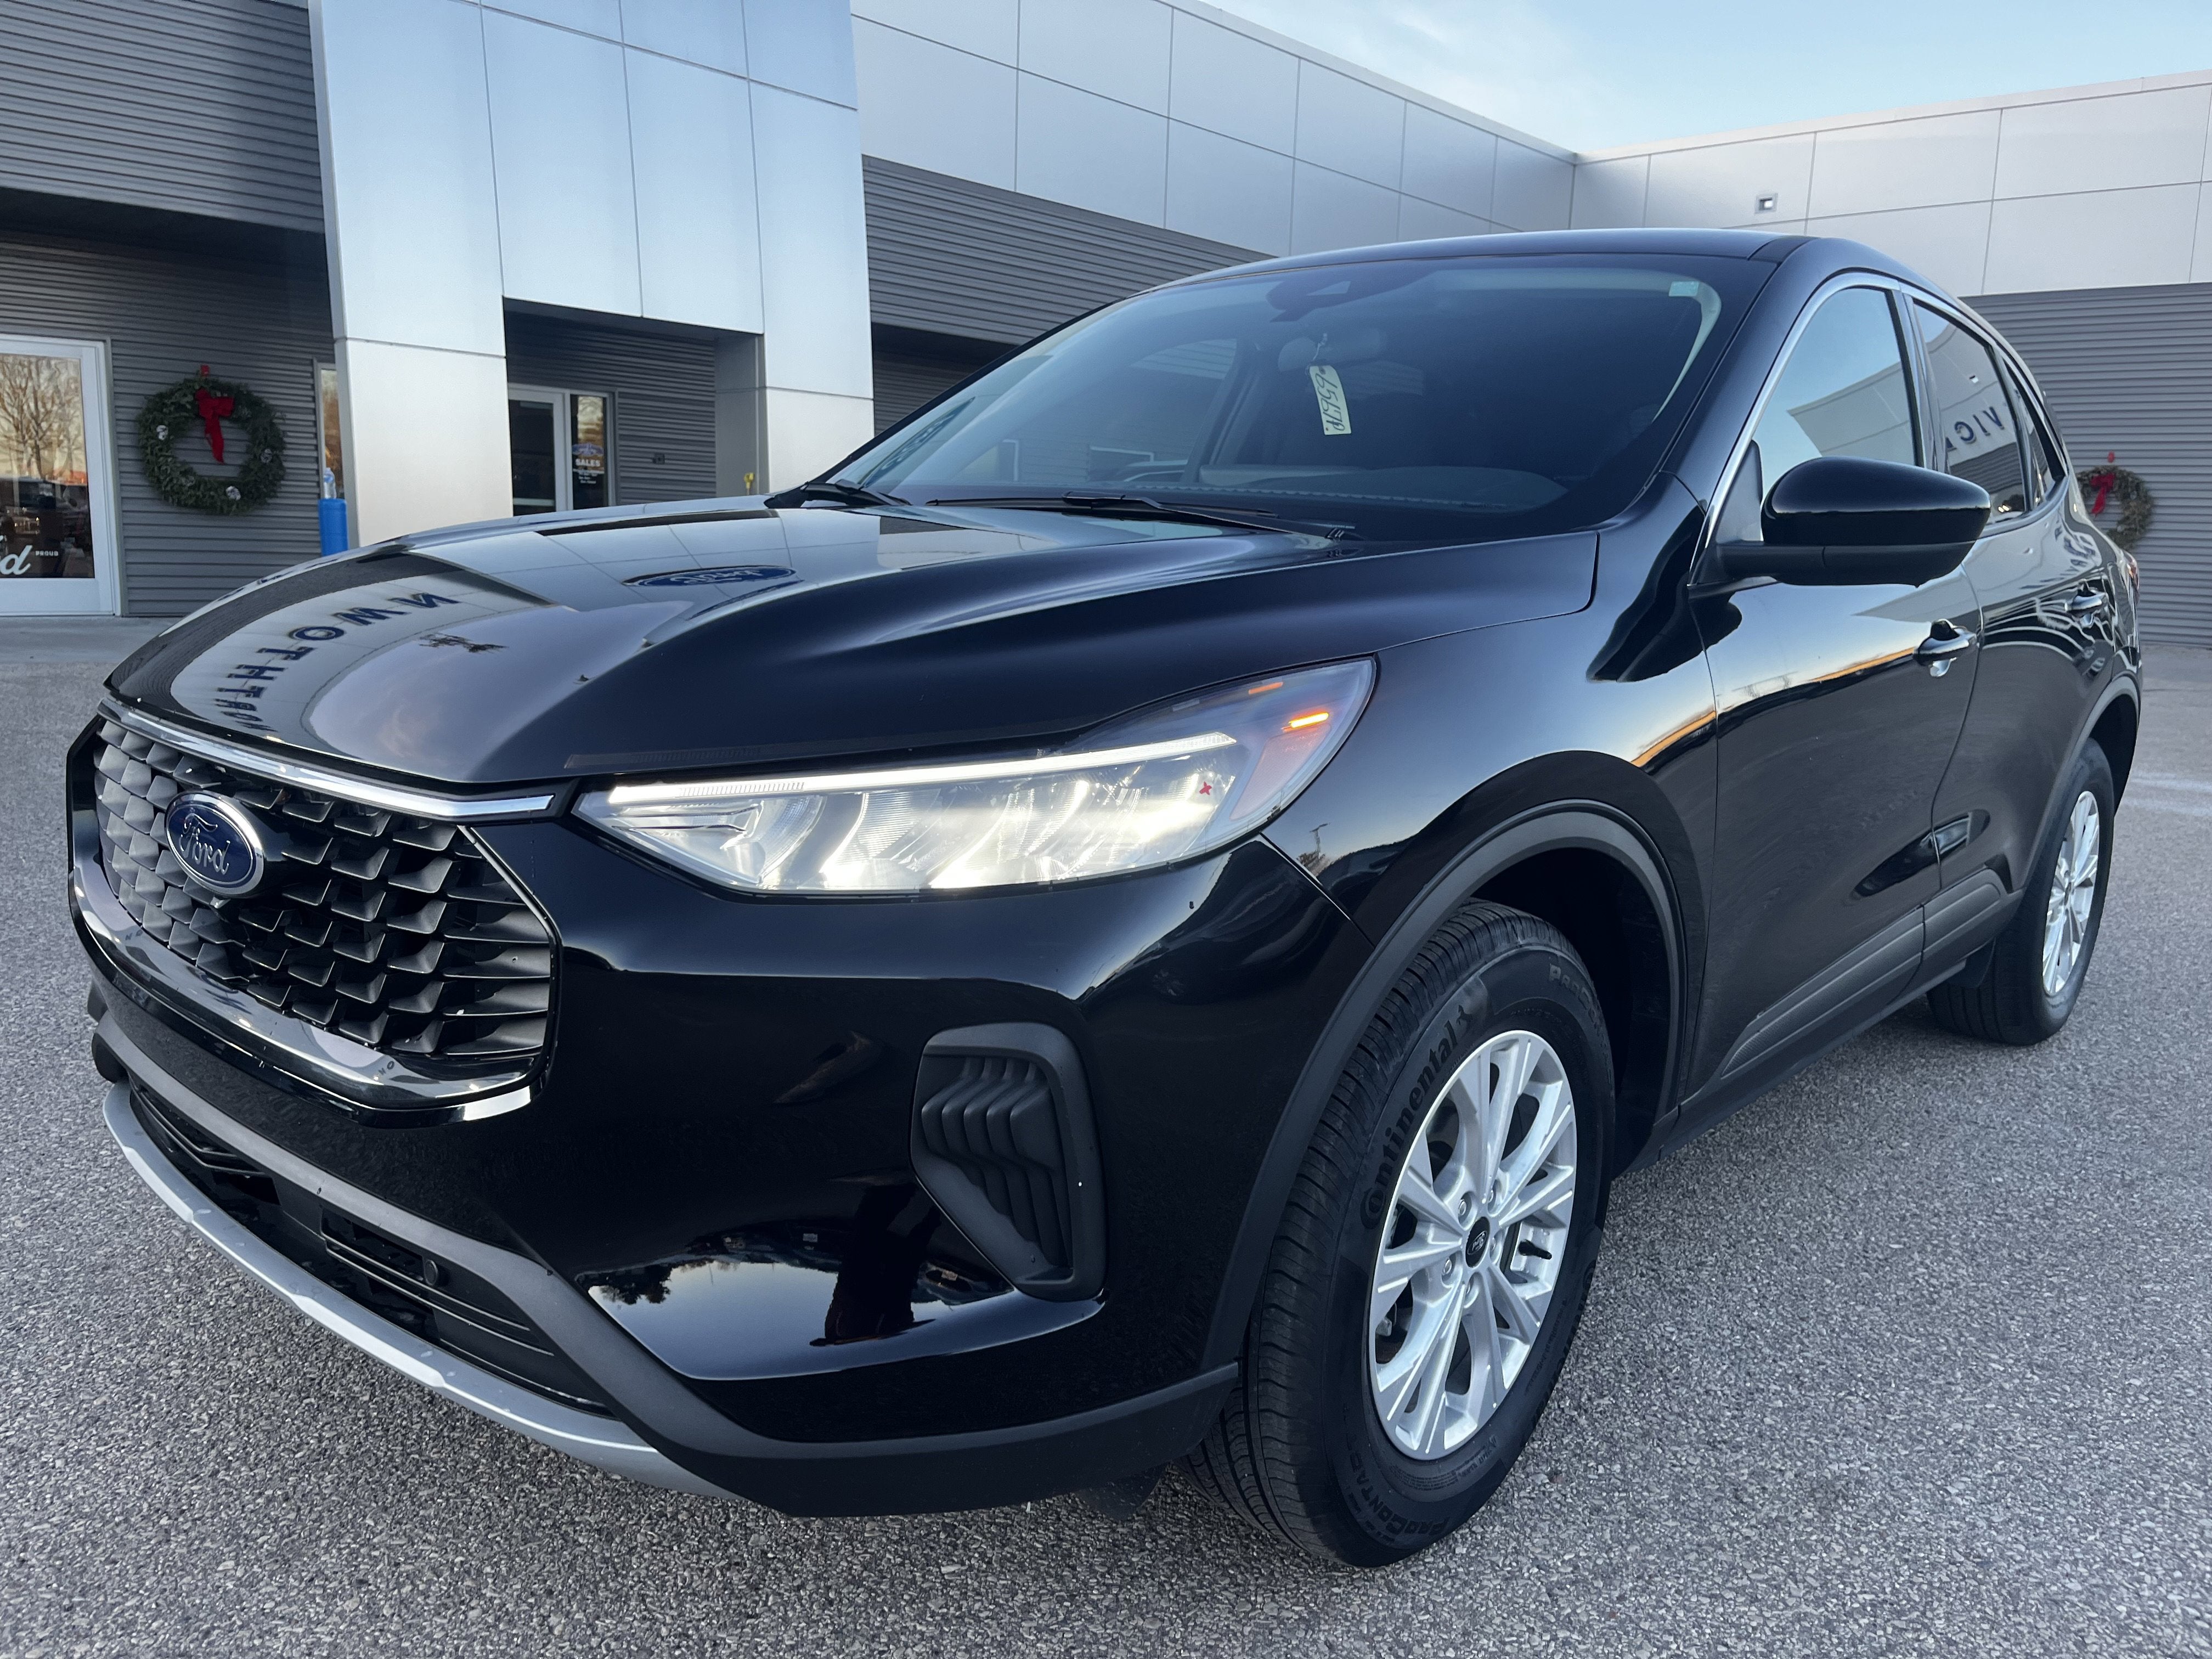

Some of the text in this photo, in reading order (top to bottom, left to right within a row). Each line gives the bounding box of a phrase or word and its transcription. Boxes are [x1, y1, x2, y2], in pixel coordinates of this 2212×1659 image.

[575, 458, 601, 467] SALES
[178, 812, 231, 876] Ford
[1360, 1020, 1459, 1230] Continental
